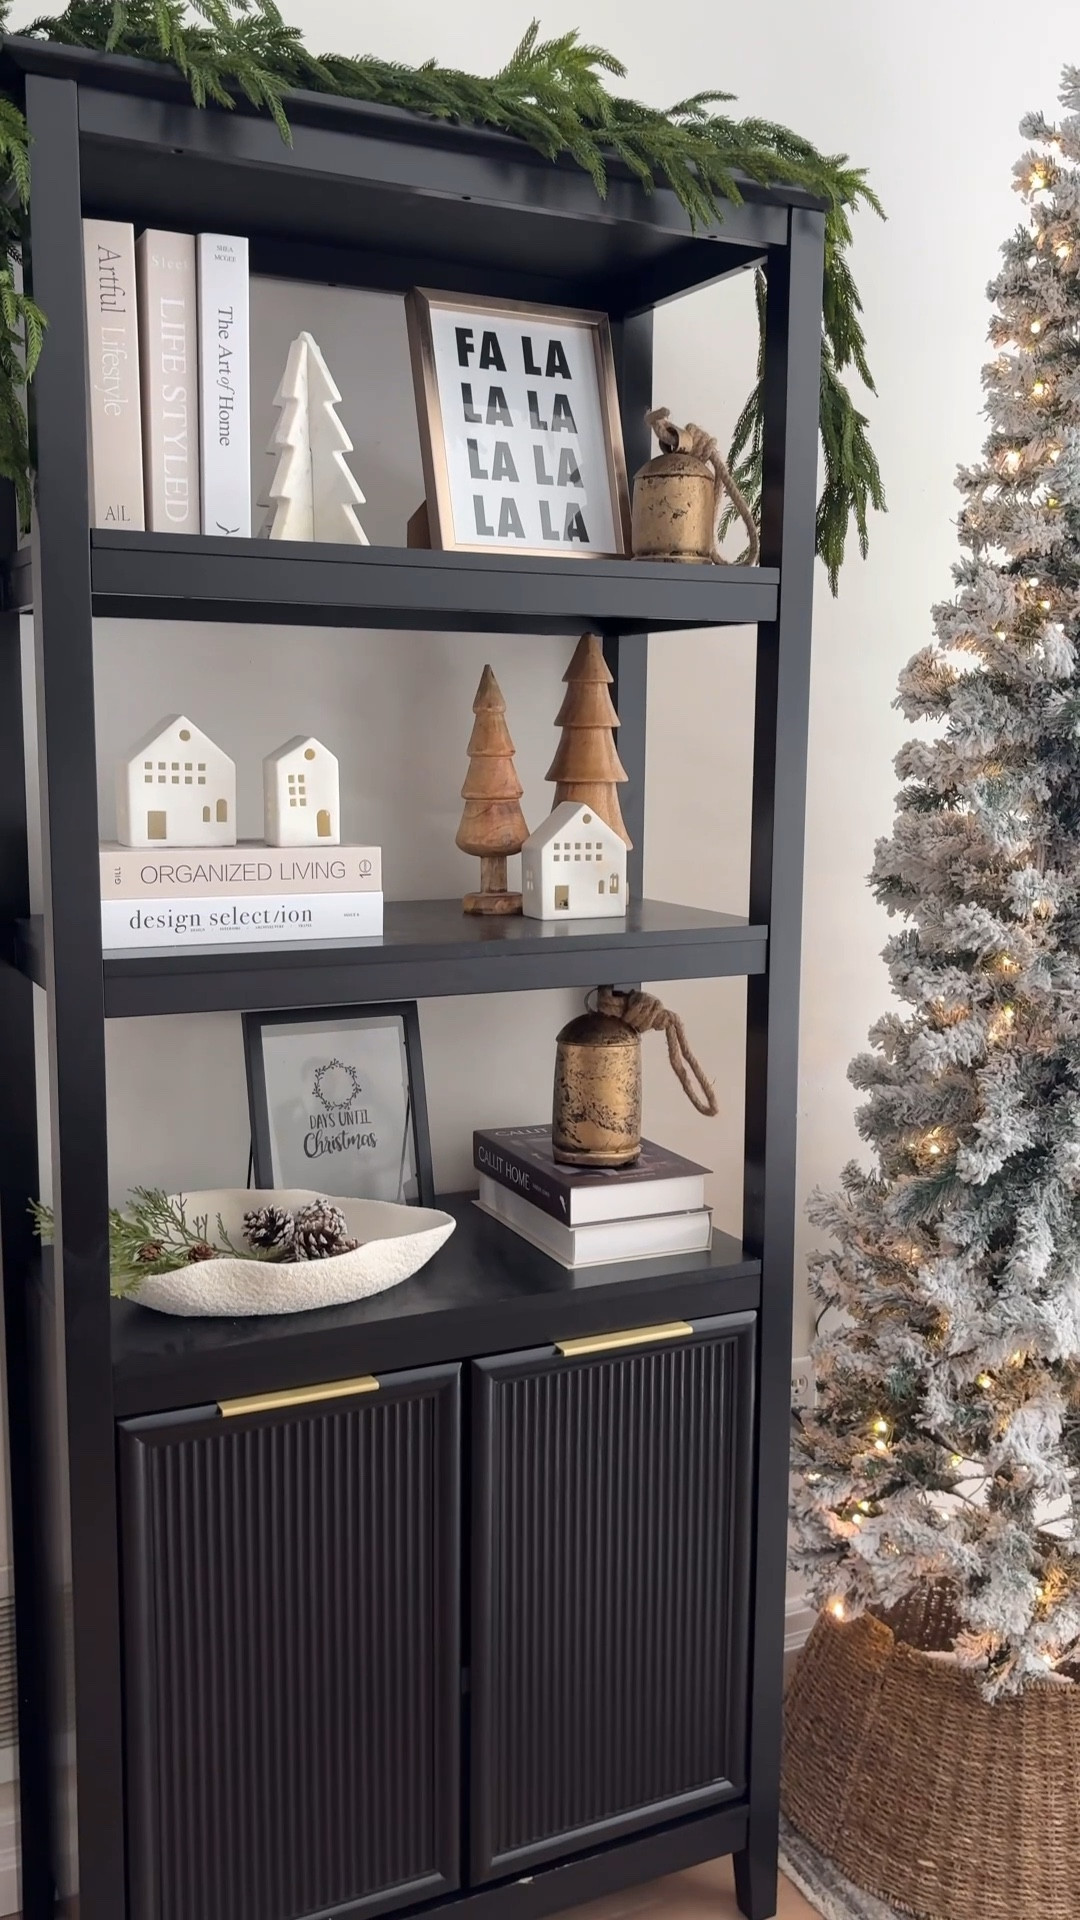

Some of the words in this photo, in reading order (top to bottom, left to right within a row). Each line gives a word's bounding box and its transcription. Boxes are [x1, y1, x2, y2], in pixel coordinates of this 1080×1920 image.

[97, 244, 126, 313] Artful
[160, 297, 187, 374] LIFE
[217, 306, 234, 340] The
[95, 325, 128, 417] Lifestyle
[217, 343, 232, 374] Art
[454, 327, 507, 373] FA
[521, 335, 573, 380] LA
[216, 375, 235, 394] of
[218, 395, 234, 447] Home
[460, 382, 514, 428] LA
[527, 390, 578, 435] LA
[162, 384, 189, 523] STYLED
[466, 437, 520, 483] LA
[533, 444, 584, 489] LA
[472, 494, 526, 539] LA
[538, 500, 591, 543] LA
[114, 866, 122, 885] GILL
[140, 863, 273, 885] ORGANIZED
[280, 860, 346, 881] LIVING
[129, 909, 201, 933] design
[309, 1113, 336, 1130] DAYS
[338, 1109, 372, 1126] UNTIL
[303, 1130, 378, 1159] Christmas
[505, 1161, 530, 1191] HOME
